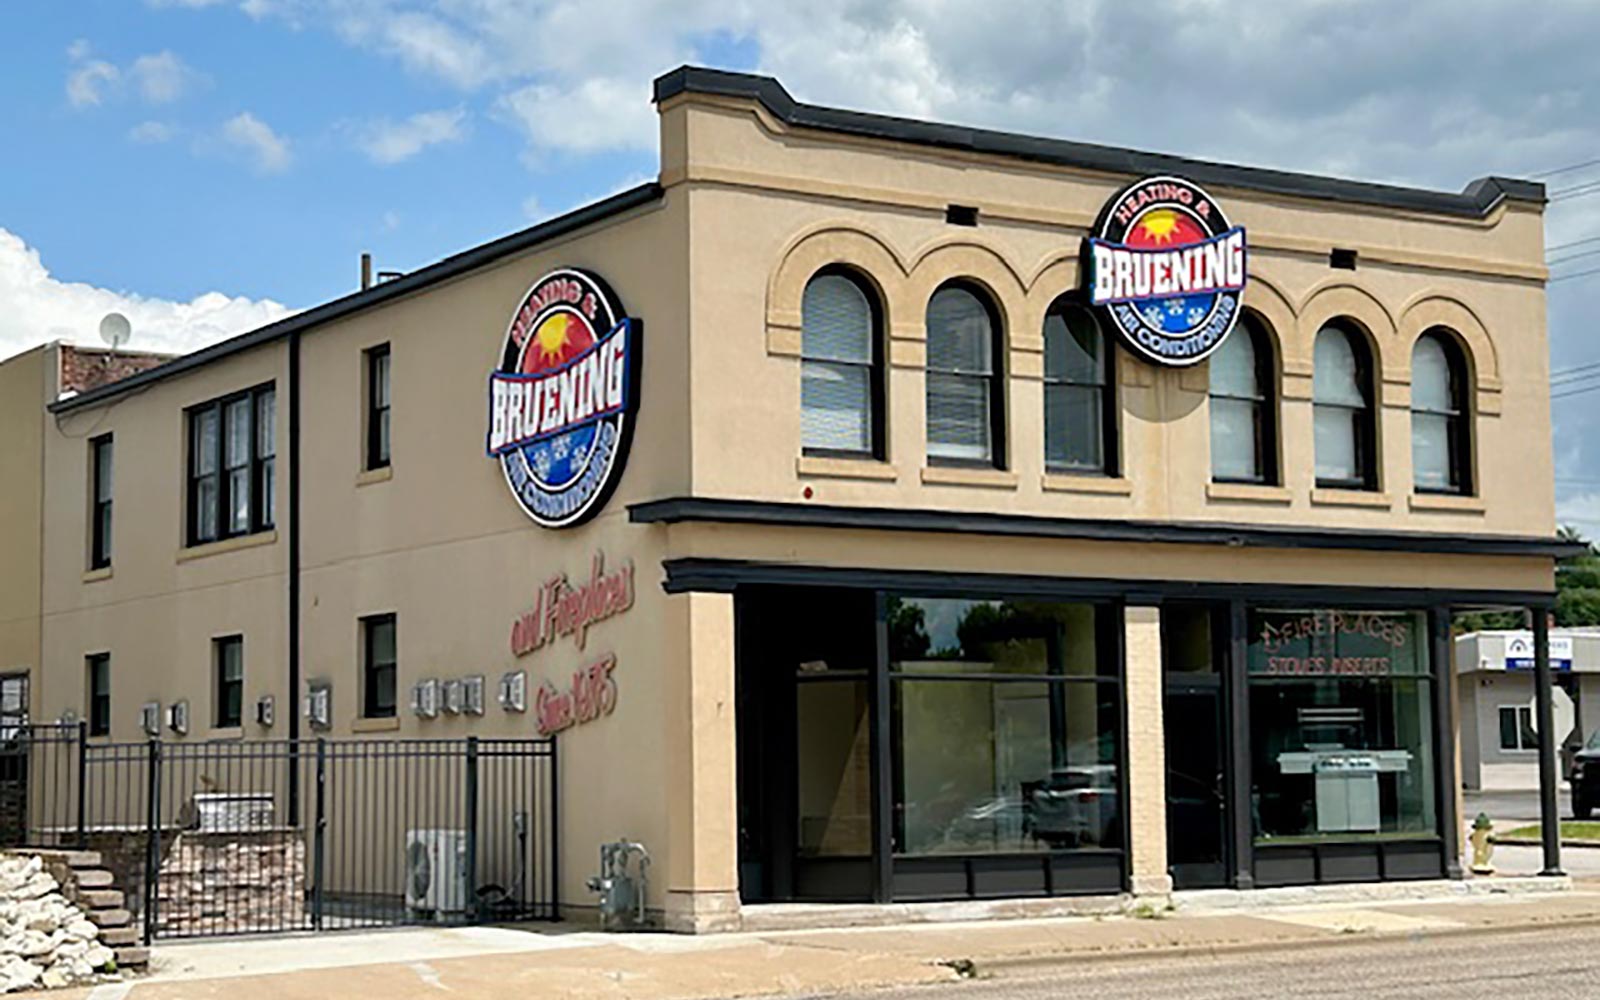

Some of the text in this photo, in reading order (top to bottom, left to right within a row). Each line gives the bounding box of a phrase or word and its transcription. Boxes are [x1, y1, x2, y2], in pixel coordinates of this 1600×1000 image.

[1115, 183, 1211, 225] HEATING &
[1093, 229, 1243, 301] BRUENING
[512, 278, 597, 348] HEATING &
[1115, 295, 1235, 356] AIR CONDITIONING
[490, 326, 626, 451] BRUENING
[525, 421, 616, 519] CONDITIONING
[511, 548, 635, 657] and Fireplaces
[1267, 656, 1392, 675] STOVES INSERTS
